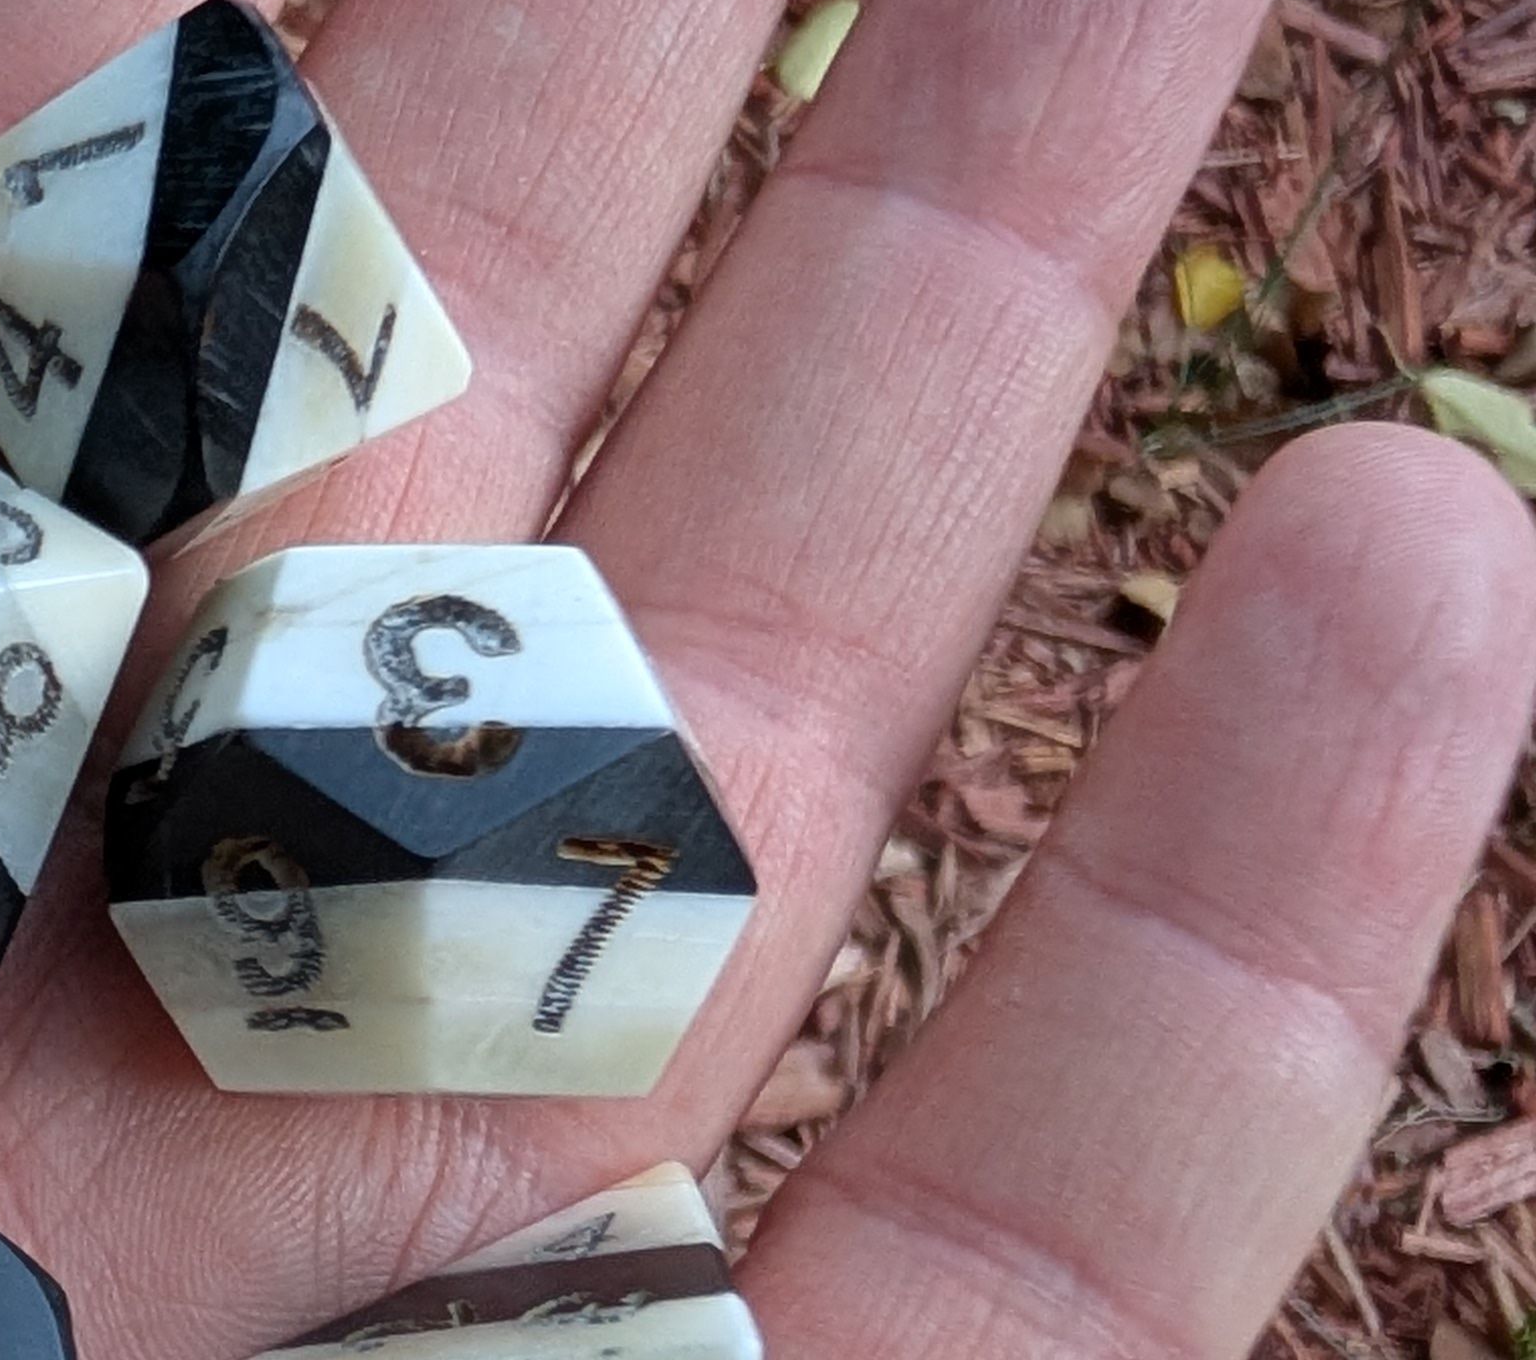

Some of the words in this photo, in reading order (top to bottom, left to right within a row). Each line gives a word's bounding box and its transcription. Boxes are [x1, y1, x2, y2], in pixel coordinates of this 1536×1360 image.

[4, 121, 146, 208] 1
[364, 594, 524, 780] 3
[532, 837, 680, 1034] 7
